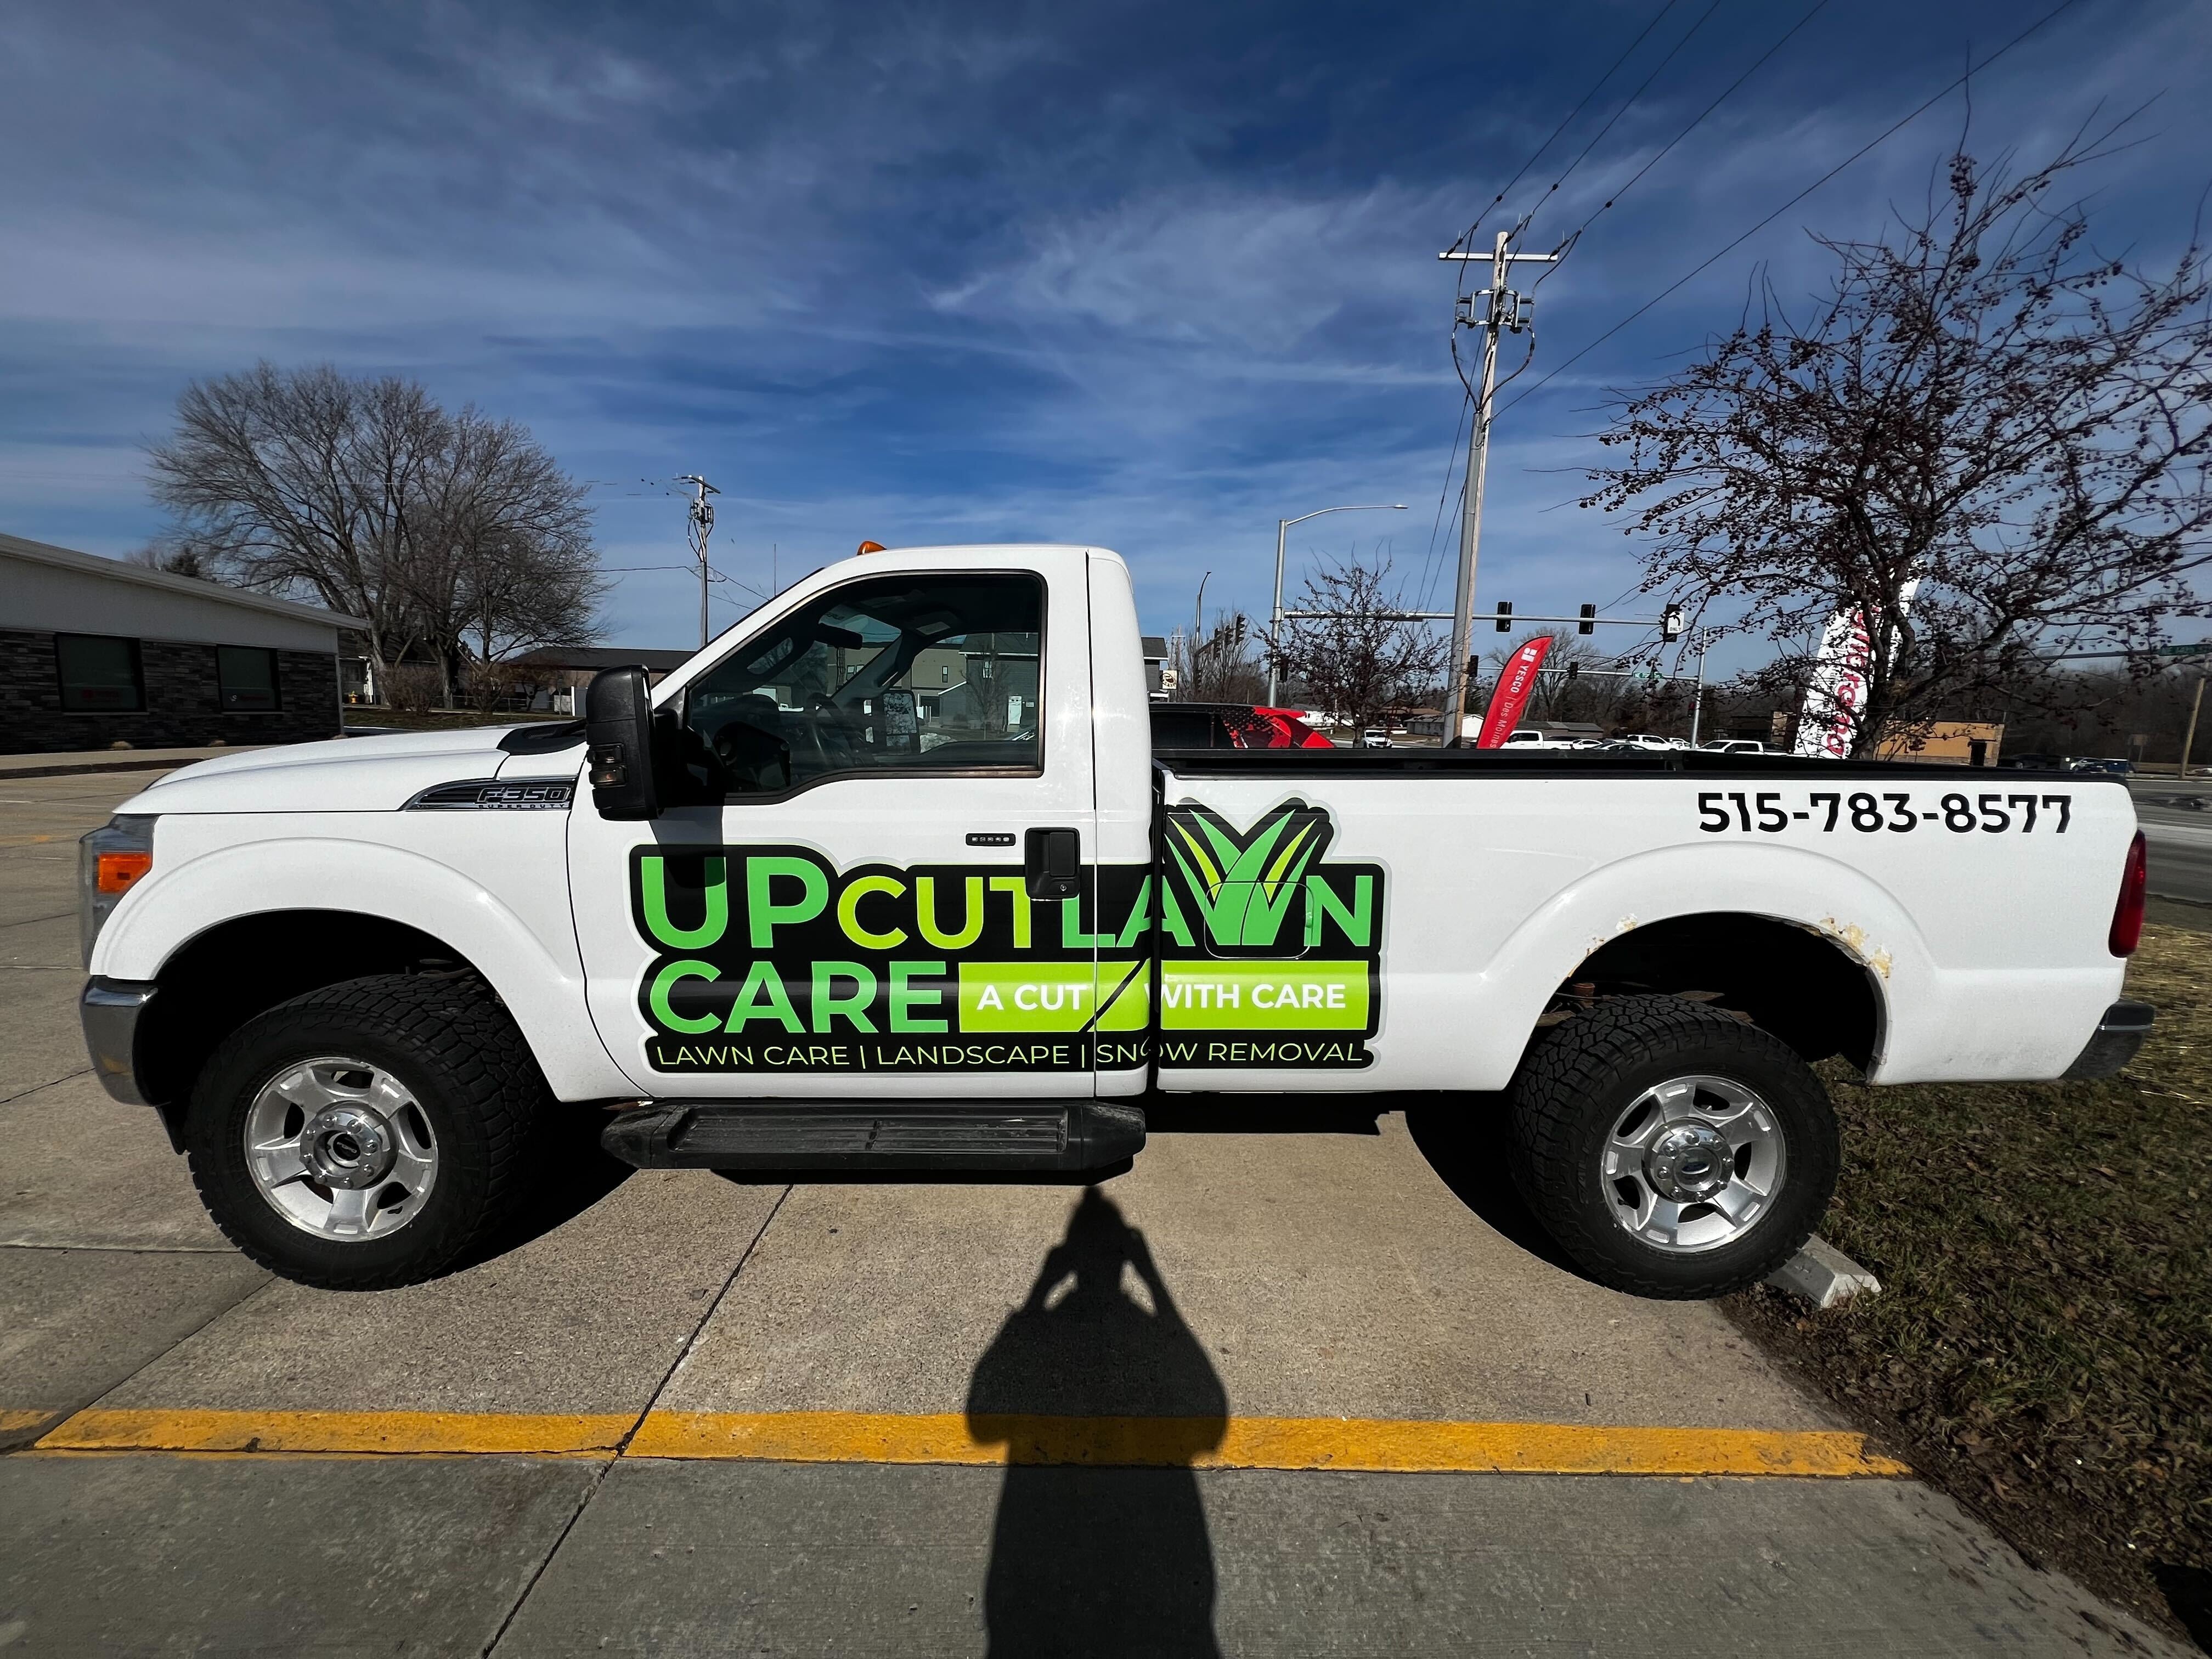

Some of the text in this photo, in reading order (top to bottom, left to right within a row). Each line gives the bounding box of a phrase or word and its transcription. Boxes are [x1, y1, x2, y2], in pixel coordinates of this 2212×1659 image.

[1489, 664, 1530, 748] YESCO Des Moines
[1698, 792, 2072, 833] 515-783-8577
[650, 960, 949, 1034] CARE
[977, 984, 1082, 1011] A CUT
[1144, 983, 1346, 1008] WITH CARE
[657, 1046, 754, 1065] LAWN
[764, 1046, 850, 1065] CARE
[877, 1046, 1070, 1065] LANDSCAPE
[1209, 1043, 1362, 1061] REMOVAL
